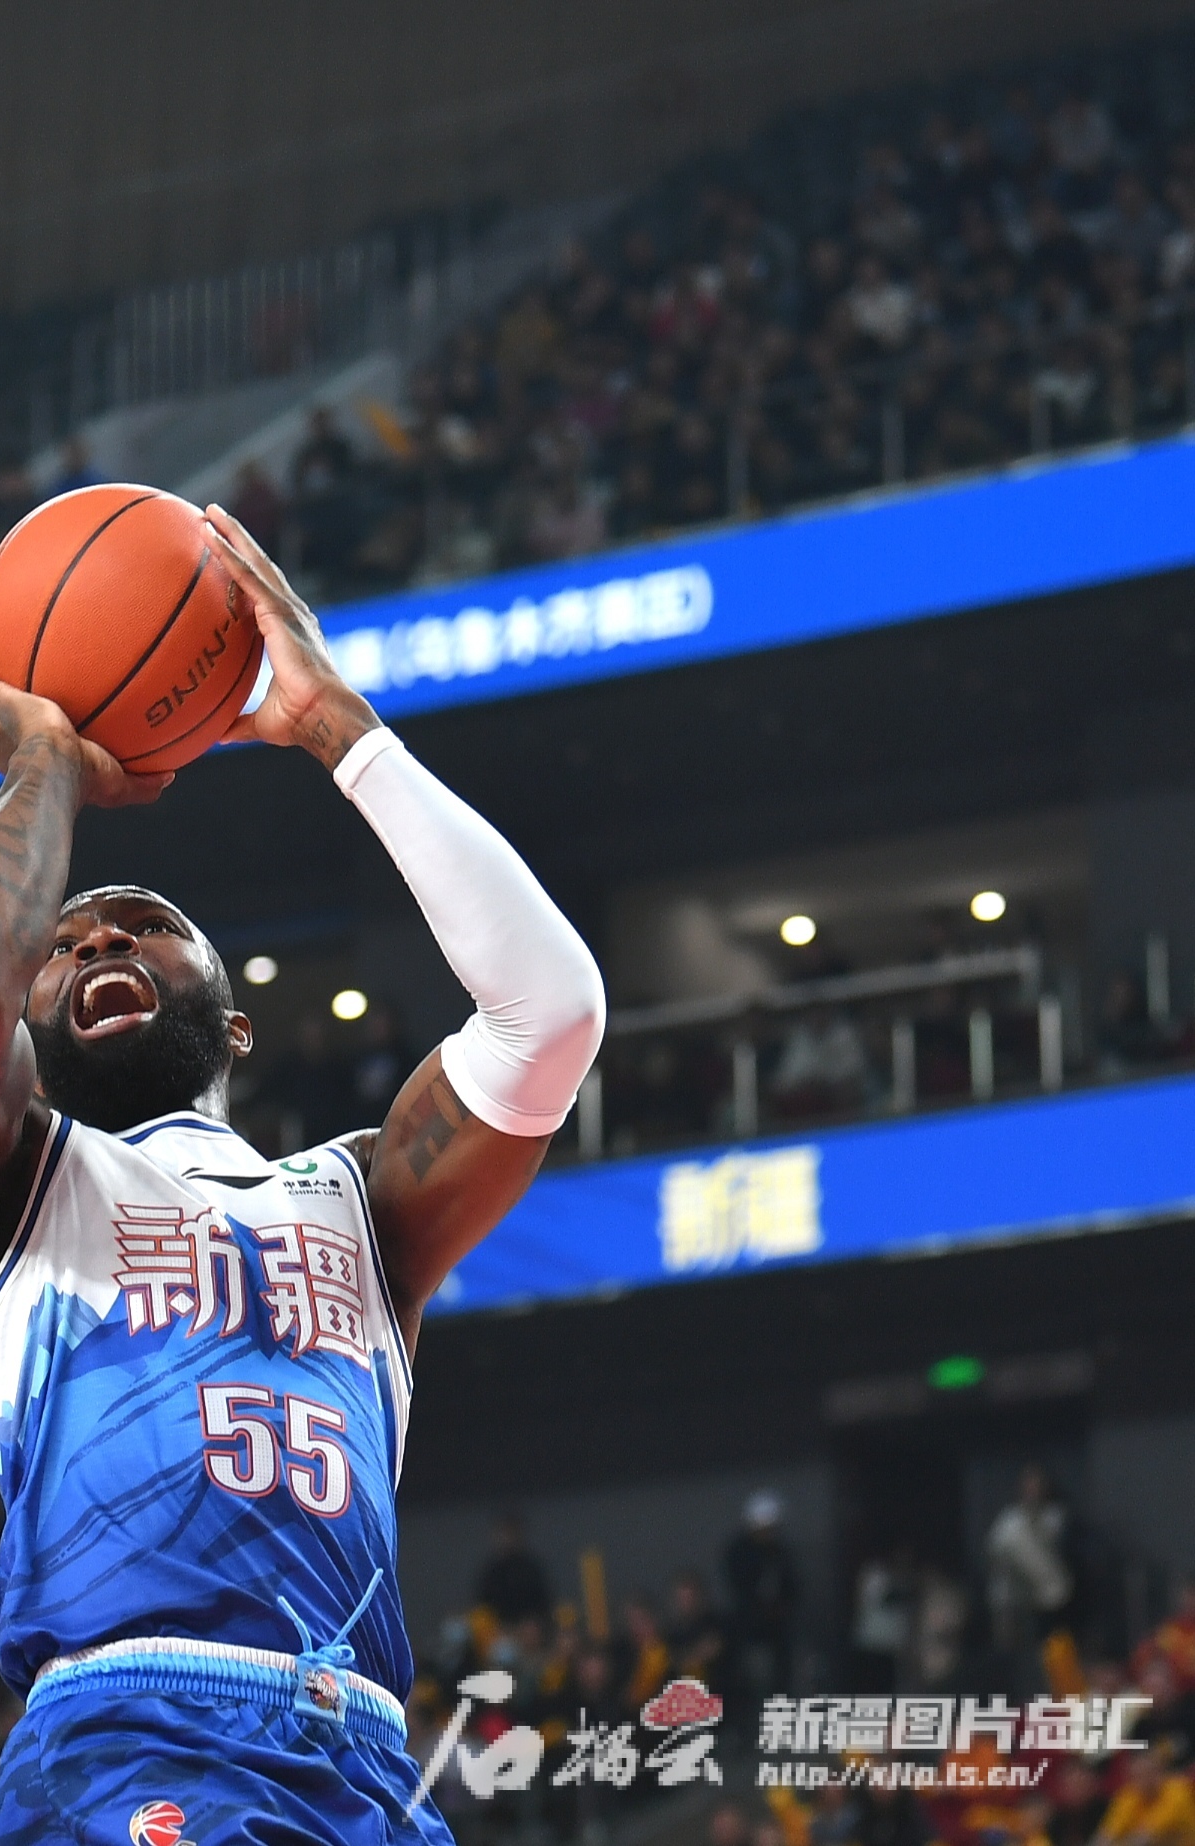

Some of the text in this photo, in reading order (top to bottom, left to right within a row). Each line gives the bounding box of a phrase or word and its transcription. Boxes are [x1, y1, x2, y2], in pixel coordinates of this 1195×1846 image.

[323, 1189, 343, 1198] LIFE
[111, 1203, 371, 1371] 新疆
[197, 1382, 351, 1518] 55
